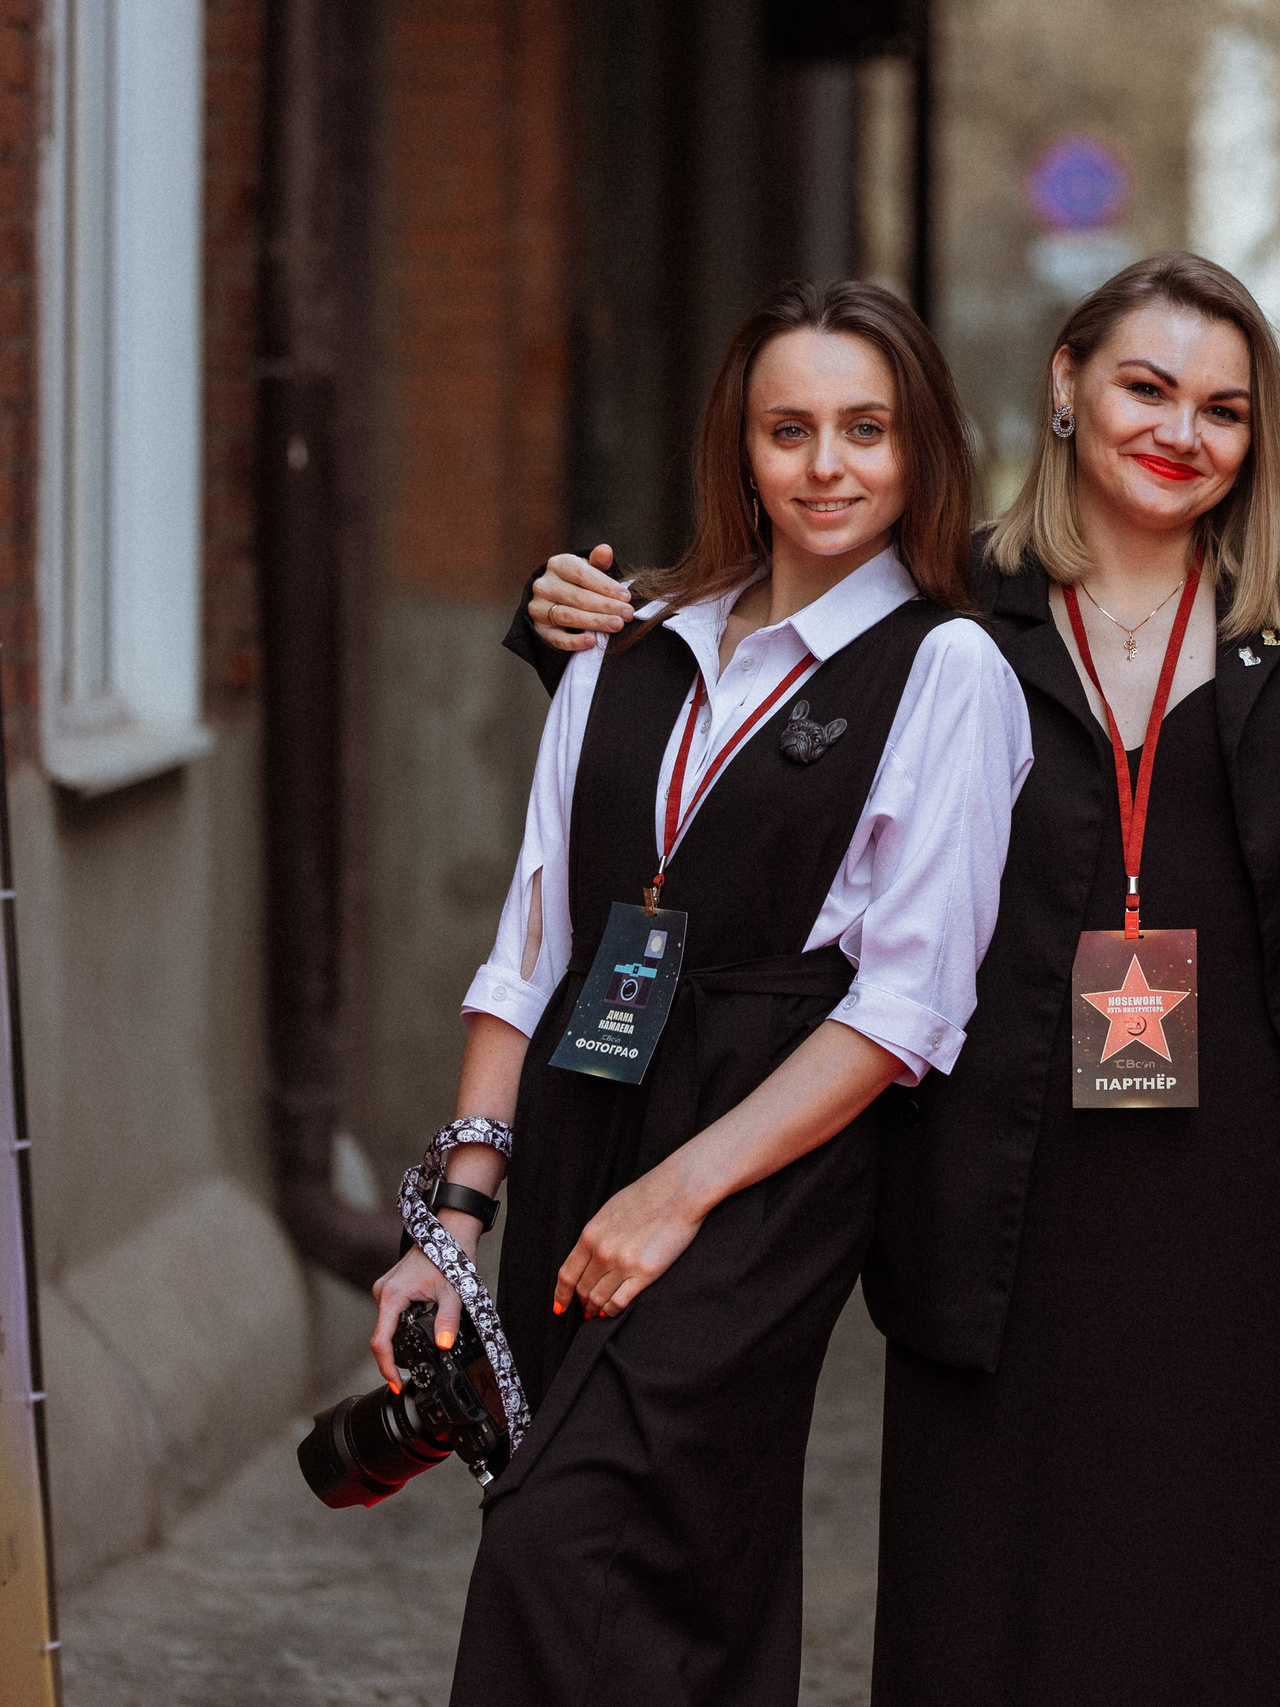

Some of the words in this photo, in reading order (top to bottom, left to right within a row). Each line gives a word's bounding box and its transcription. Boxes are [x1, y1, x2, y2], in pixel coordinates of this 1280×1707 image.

[1108, 996, 1163, 1006] NOSEWORK
[606, 1010, 634, 1023] ДИАНА
[598, 1019, 635, 1034] КАМАЕВА
[575, 1038, 639, 1059] ФОТОГРАФ
[1095, 1074, 1177, 1091] ПАРТНЁР
